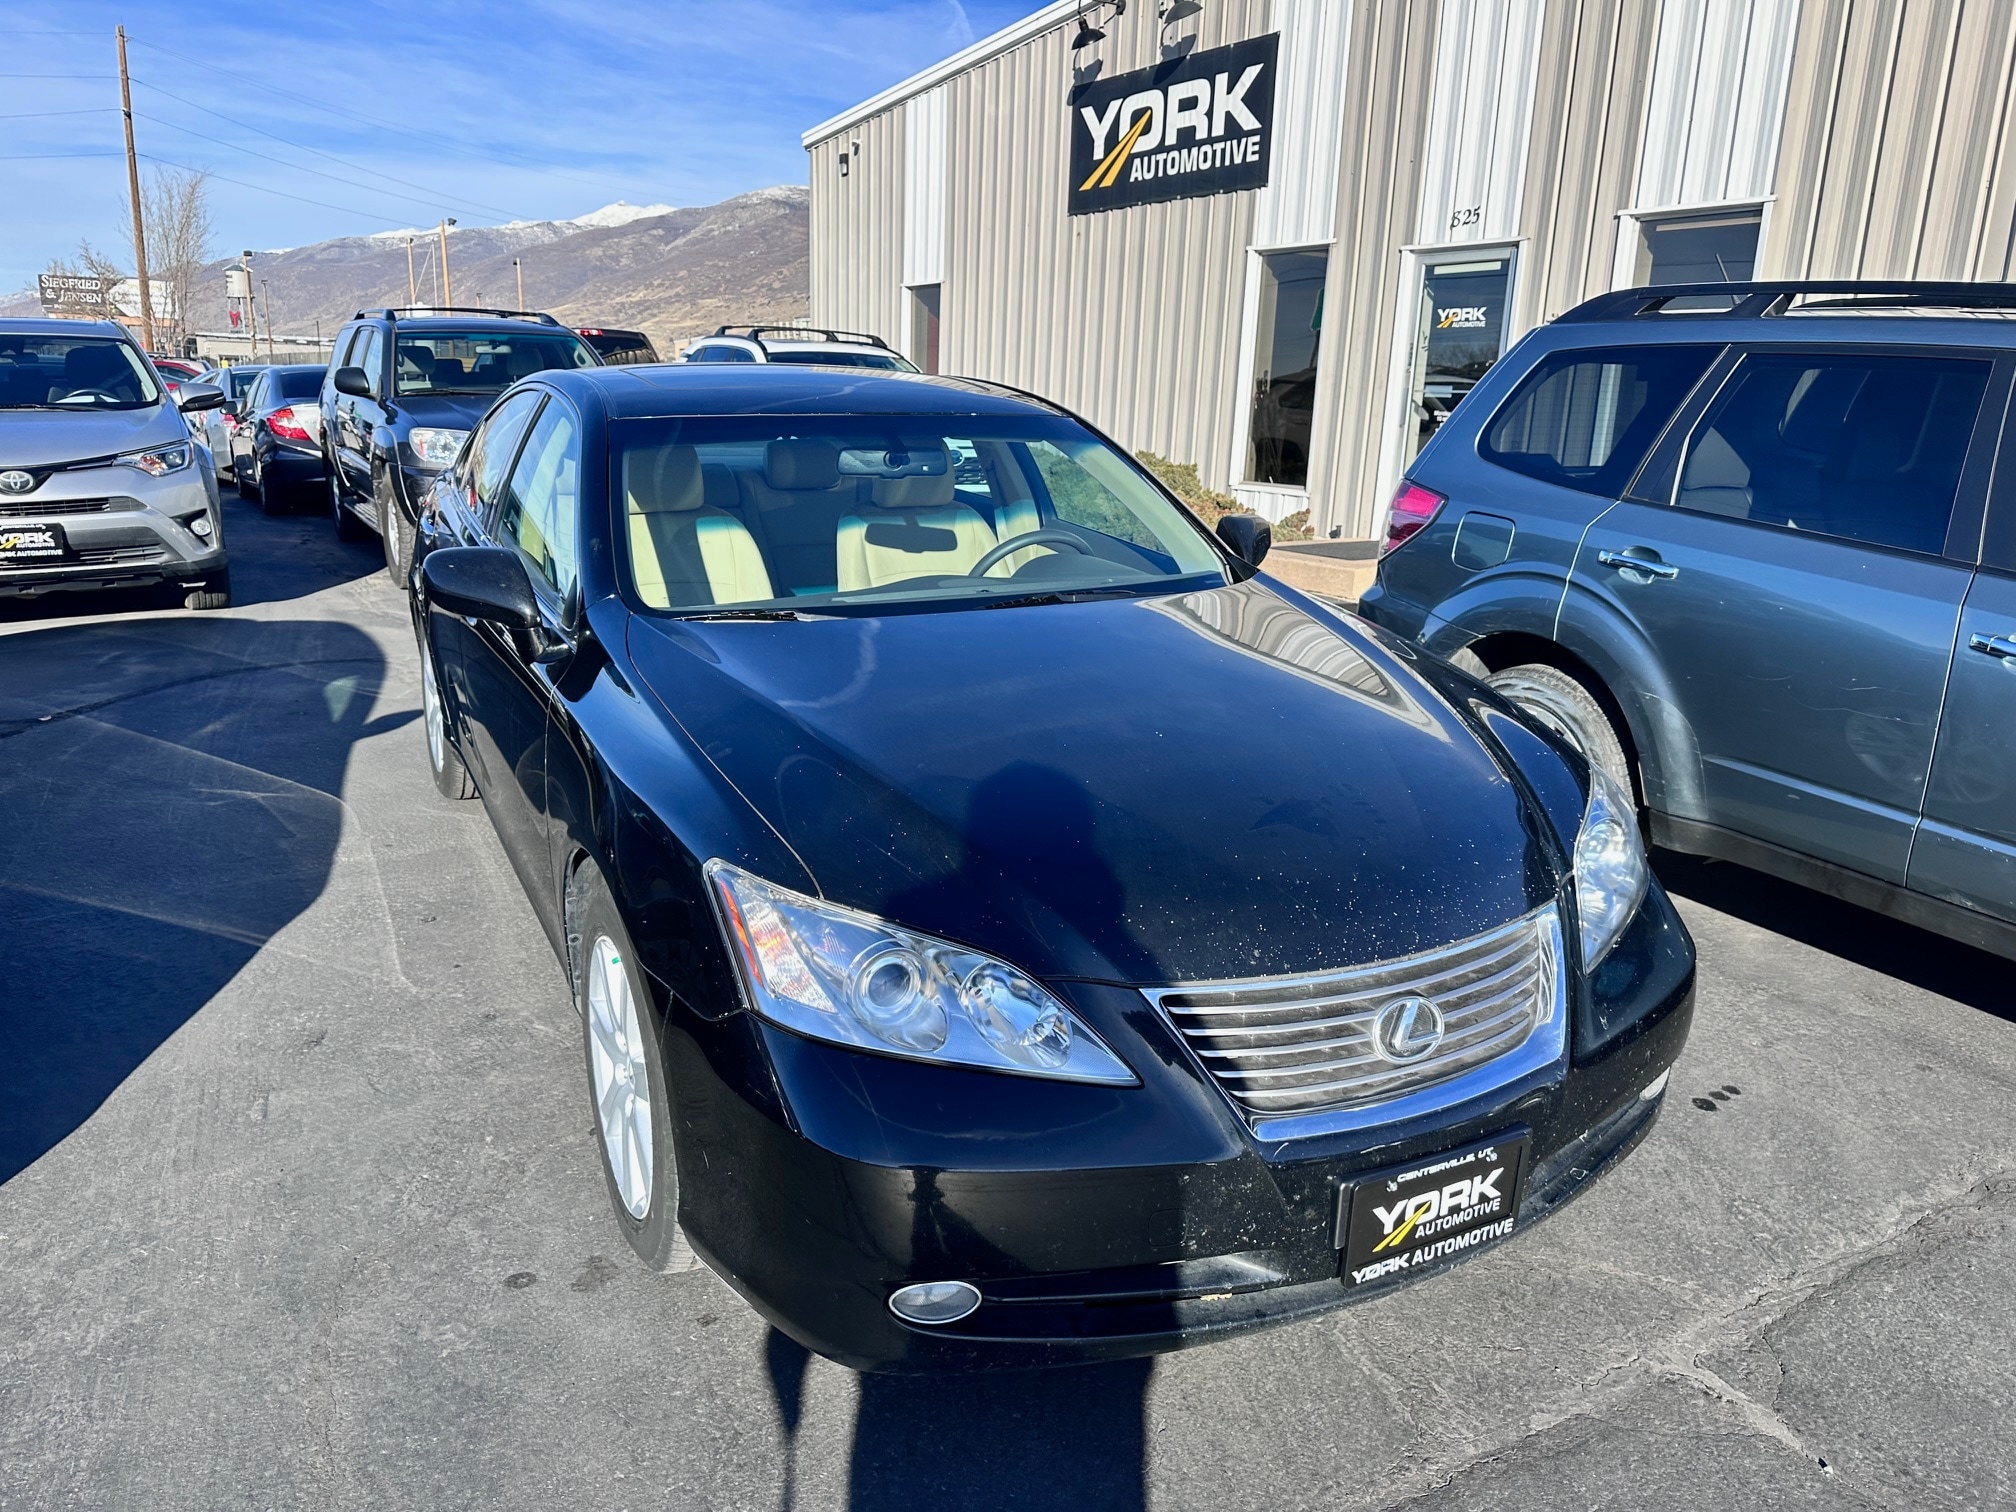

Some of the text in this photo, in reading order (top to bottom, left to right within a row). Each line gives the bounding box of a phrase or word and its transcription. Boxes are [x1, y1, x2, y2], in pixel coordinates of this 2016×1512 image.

[1080, 63, 1264, 161] YORK
[1129, 134, 1261, 183] AUTOMOTIVE
[1450, 205, 1481, 228] 825
[41, 275, 101, 290] SIEGFRIED
[45, 288, 103, 303] & JENSEN
[1437, 306, 1488, 322] YORK
[1451, 320, 1487, 328] AUTOMOTIVE
[16, 541, 56, 549] AUTOMOTIVE
[17, 549, 64, 557] AUTOMOTIVE
[1372, 1167, 1505, 1235] YORK
[1415, 1197, 1501, 1239] AUTOMOTIVE
[1351, 1217, 1515, 1284] YORK AUTOMOTIVE
